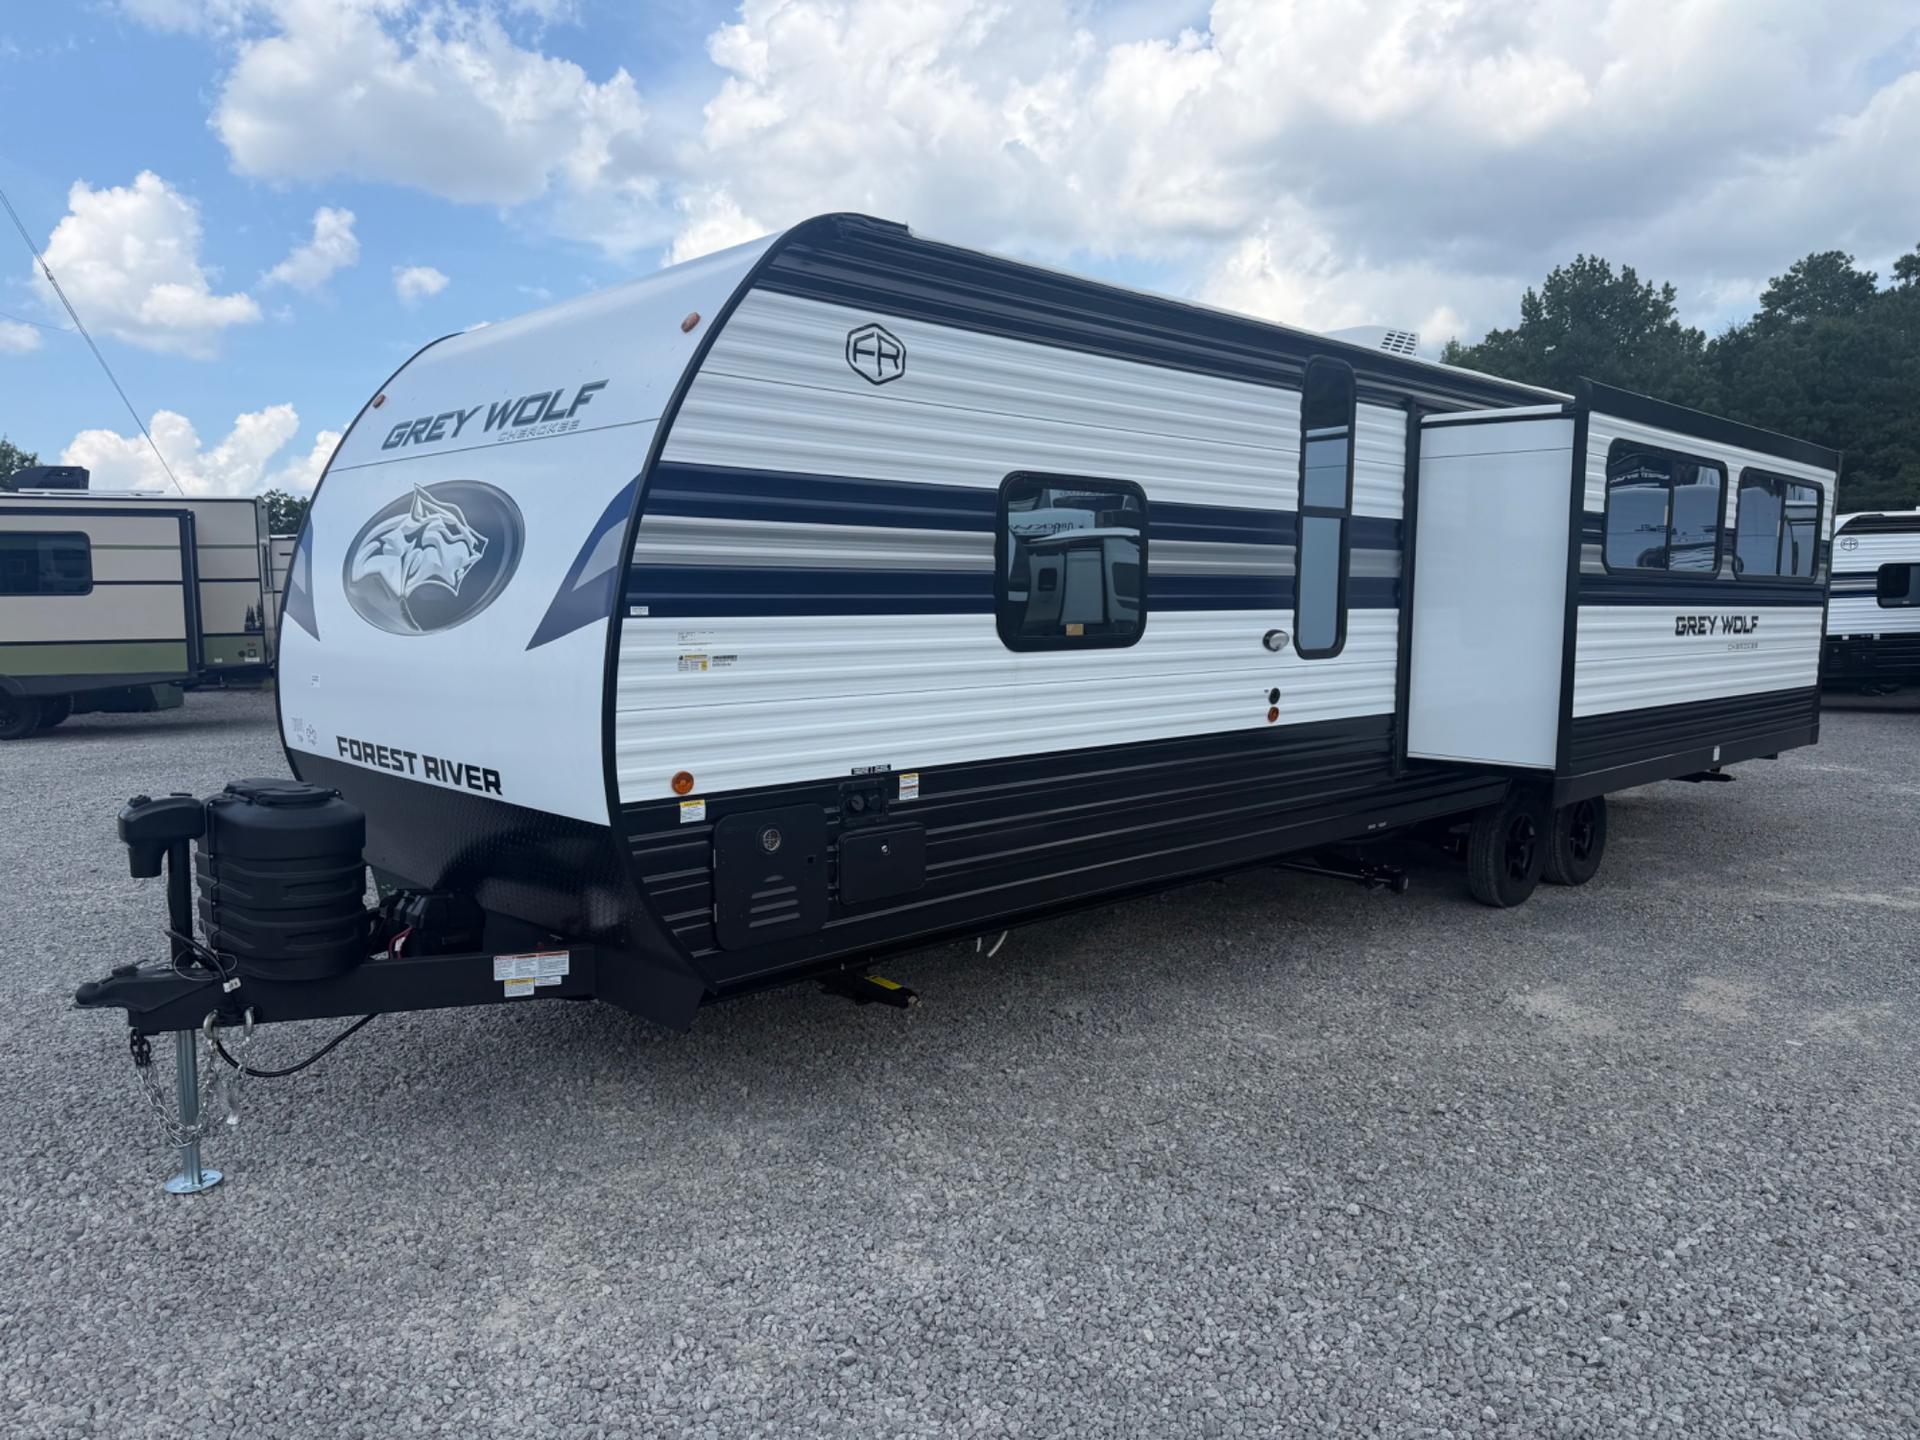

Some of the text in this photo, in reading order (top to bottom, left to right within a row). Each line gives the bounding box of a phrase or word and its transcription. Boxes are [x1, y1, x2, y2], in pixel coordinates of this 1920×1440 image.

[381, 379, 610, 451] GREY WOLF
[497, 419, 581, 442] CHEROKEE
[1675, 615, 1759, 636] GREY WOLF
[336, 735, 503, 796] FOREST RIVER
